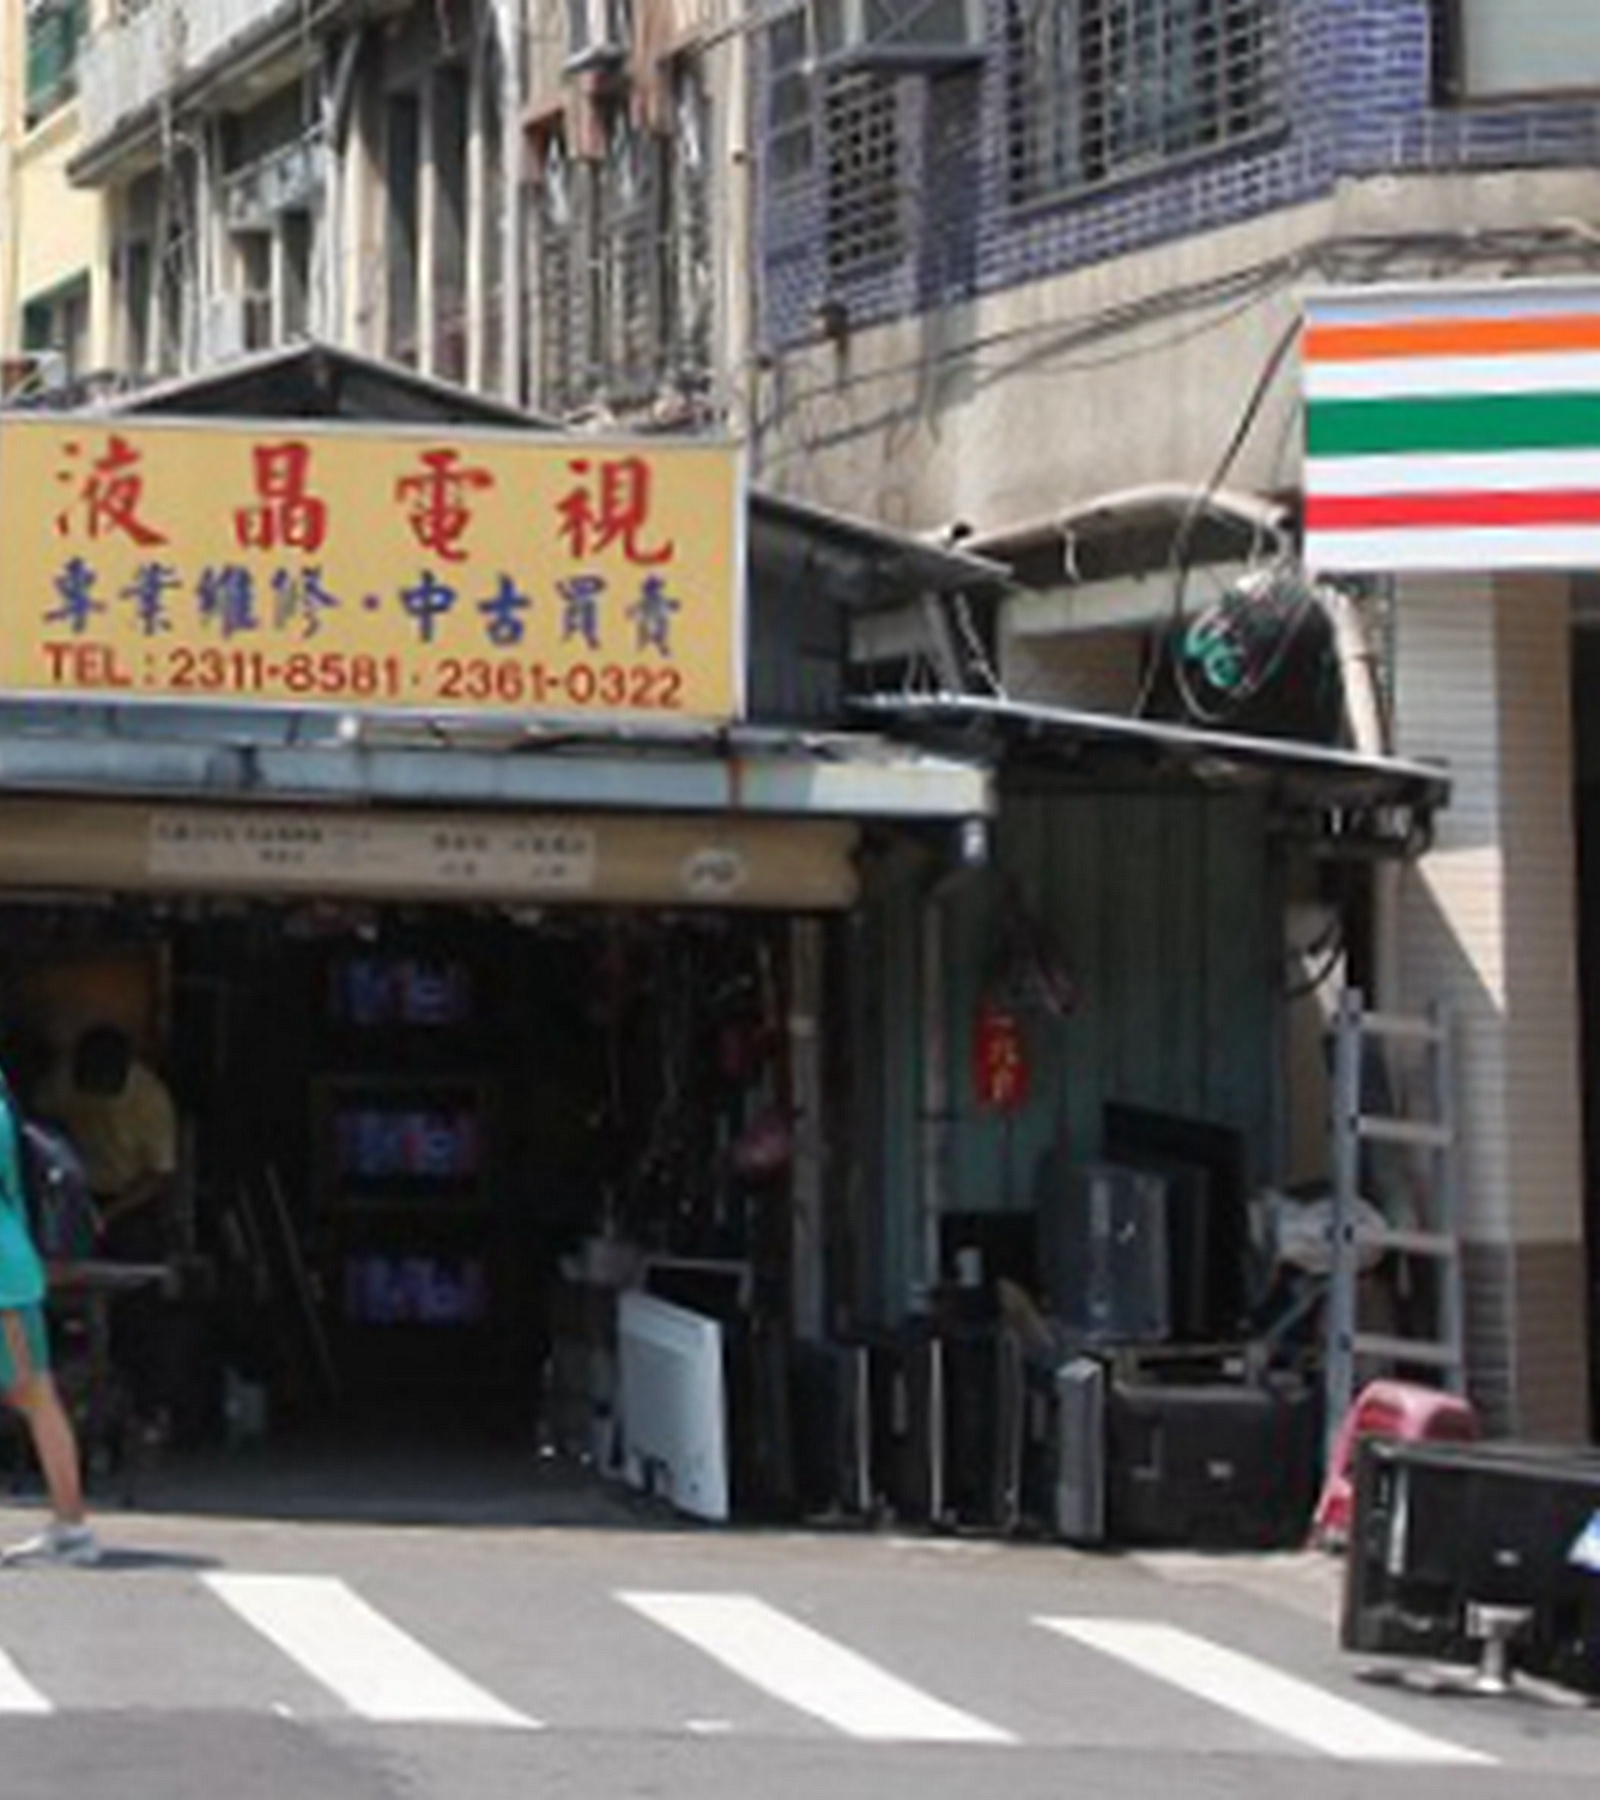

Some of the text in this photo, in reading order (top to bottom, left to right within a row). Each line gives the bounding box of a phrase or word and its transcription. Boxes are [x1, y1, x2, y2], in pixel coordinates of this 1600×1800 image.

[55, 434, 674, 566] 液晶電視
[169, 647, 399, 697] 2311-8581
[437, 657, 683, 708] 2361-0322
